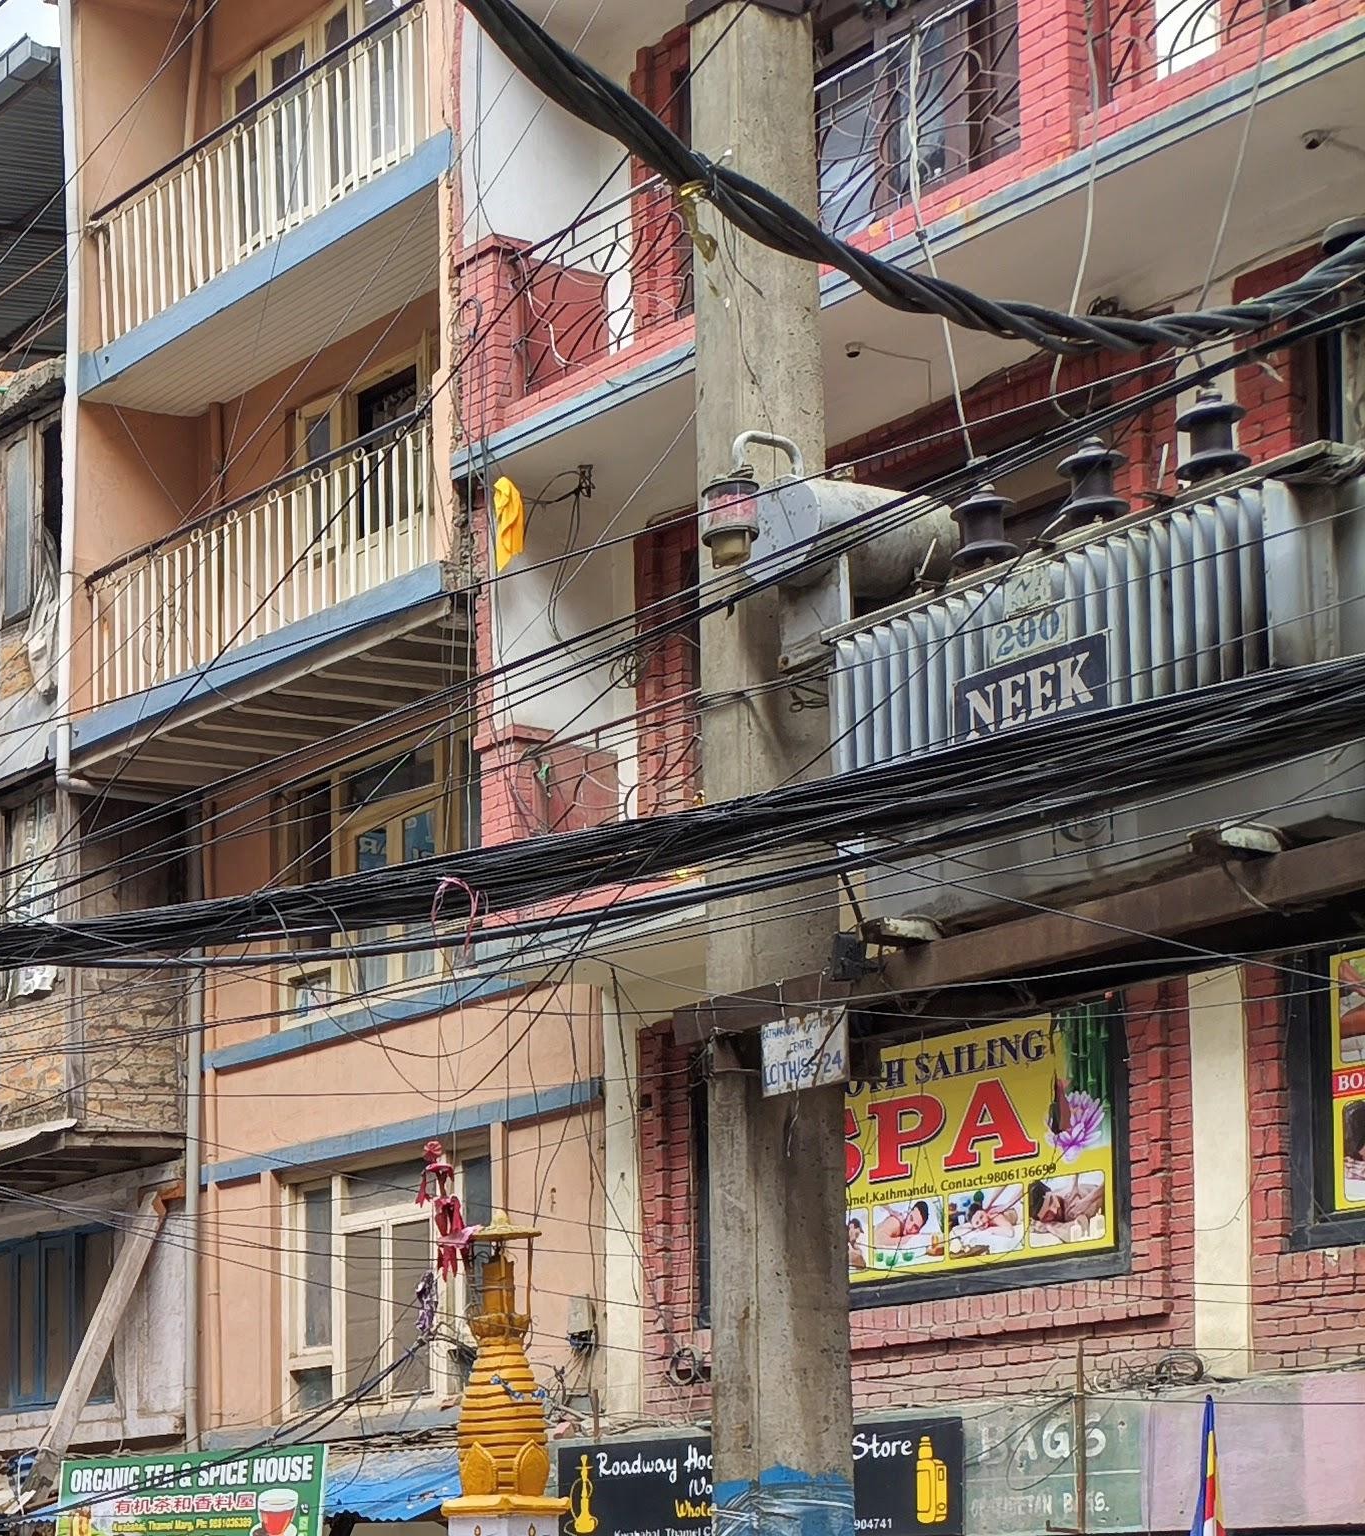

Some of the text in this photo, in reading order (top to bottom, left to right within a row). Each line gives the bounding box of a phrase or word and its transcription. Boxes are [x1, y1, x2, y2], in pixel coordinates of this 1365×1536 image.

[995, 606, 1060, 660] 200
[965, 651, 1094, 742] NEEK
[914, 1030, 1045, 1087] SAILING
[851, 1431, 914, 1460] Store
[70, 1466, 140, 1493] ORGANIC
[145, 1463, 175, 1489] TEA
[197, 1458, 249, 1487] SPICE
[253, 1454, 314, 1483] HOUSE
[595, 1452, 678, 1483] Roadway
[115, 1491, 257, 1517] 有机茶和香料屋
[853, 1517, 893, 1530] 904741
